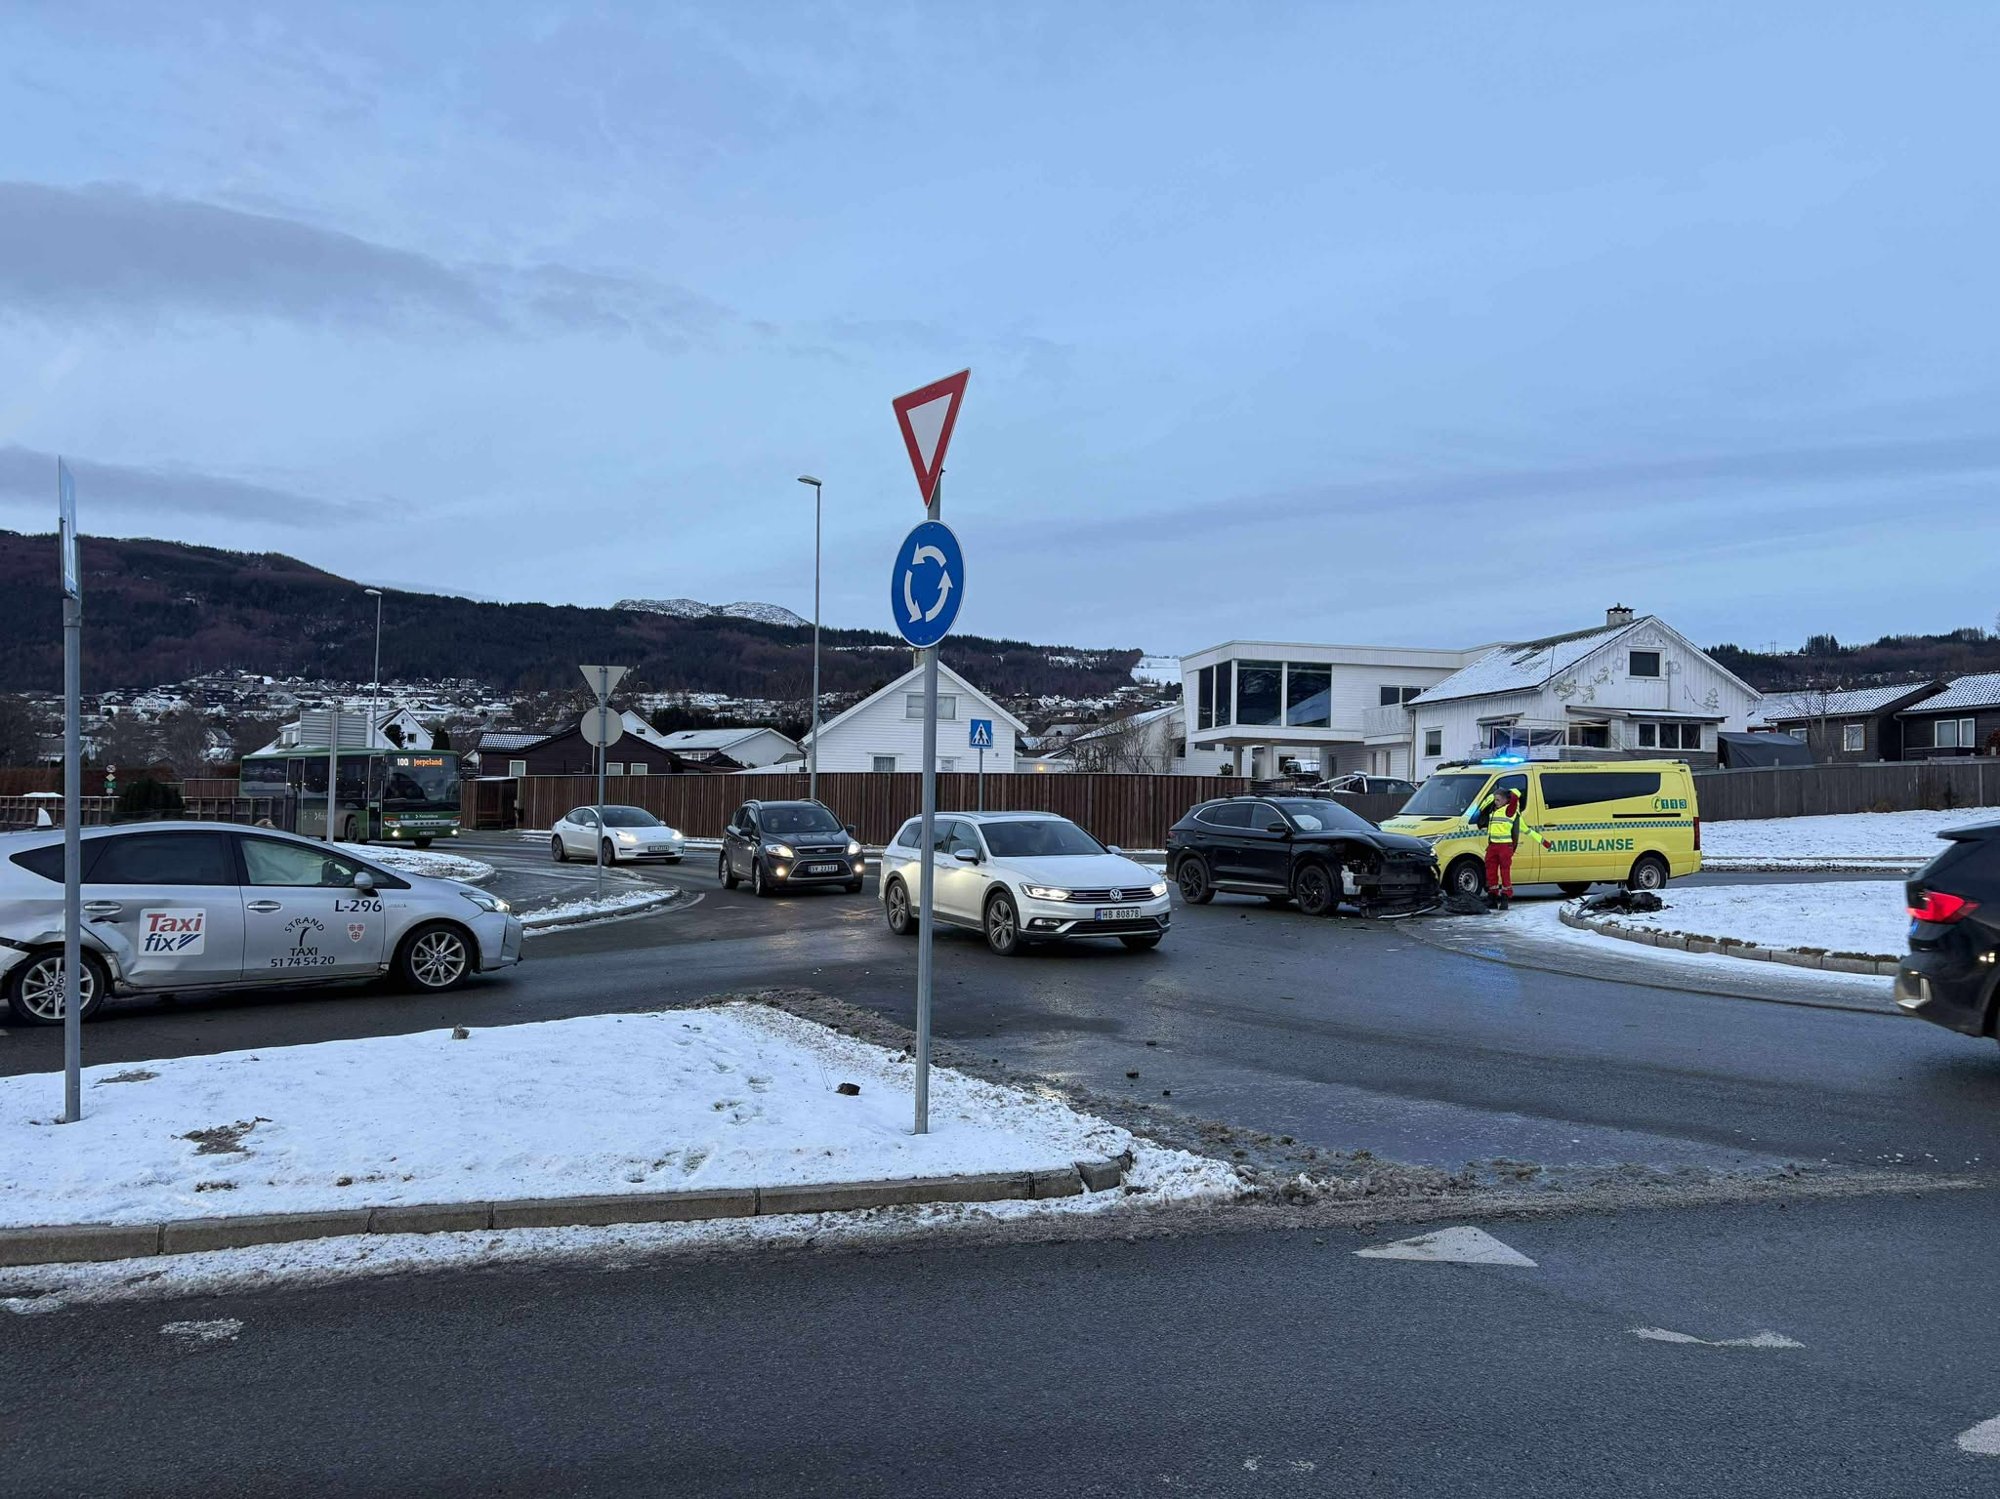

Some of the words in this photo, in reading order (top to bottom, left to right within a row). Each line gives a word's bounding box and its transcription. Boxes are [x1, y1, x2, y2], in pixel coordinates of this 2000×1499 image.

[397, 758, 409, 766] 100
[1661, 799, 1687, 809] 113
[1548, 839, 1634, 852] AMBULANSE
[335, 900, 382, 912] L-296
[1103, 910, 1113, 919] HB
[146, 913, 203, 932] Taxi
[284, 917, 325, 933] STRAND
[144, 933, 177, 951] fix
[289, 947, 318, 957] TAXI
[270, 958, 283, 967] 51
[287, 957, 301, 967] 74
[304, 957, 318, 966] 54
[320, 956, 335, 965] 20
